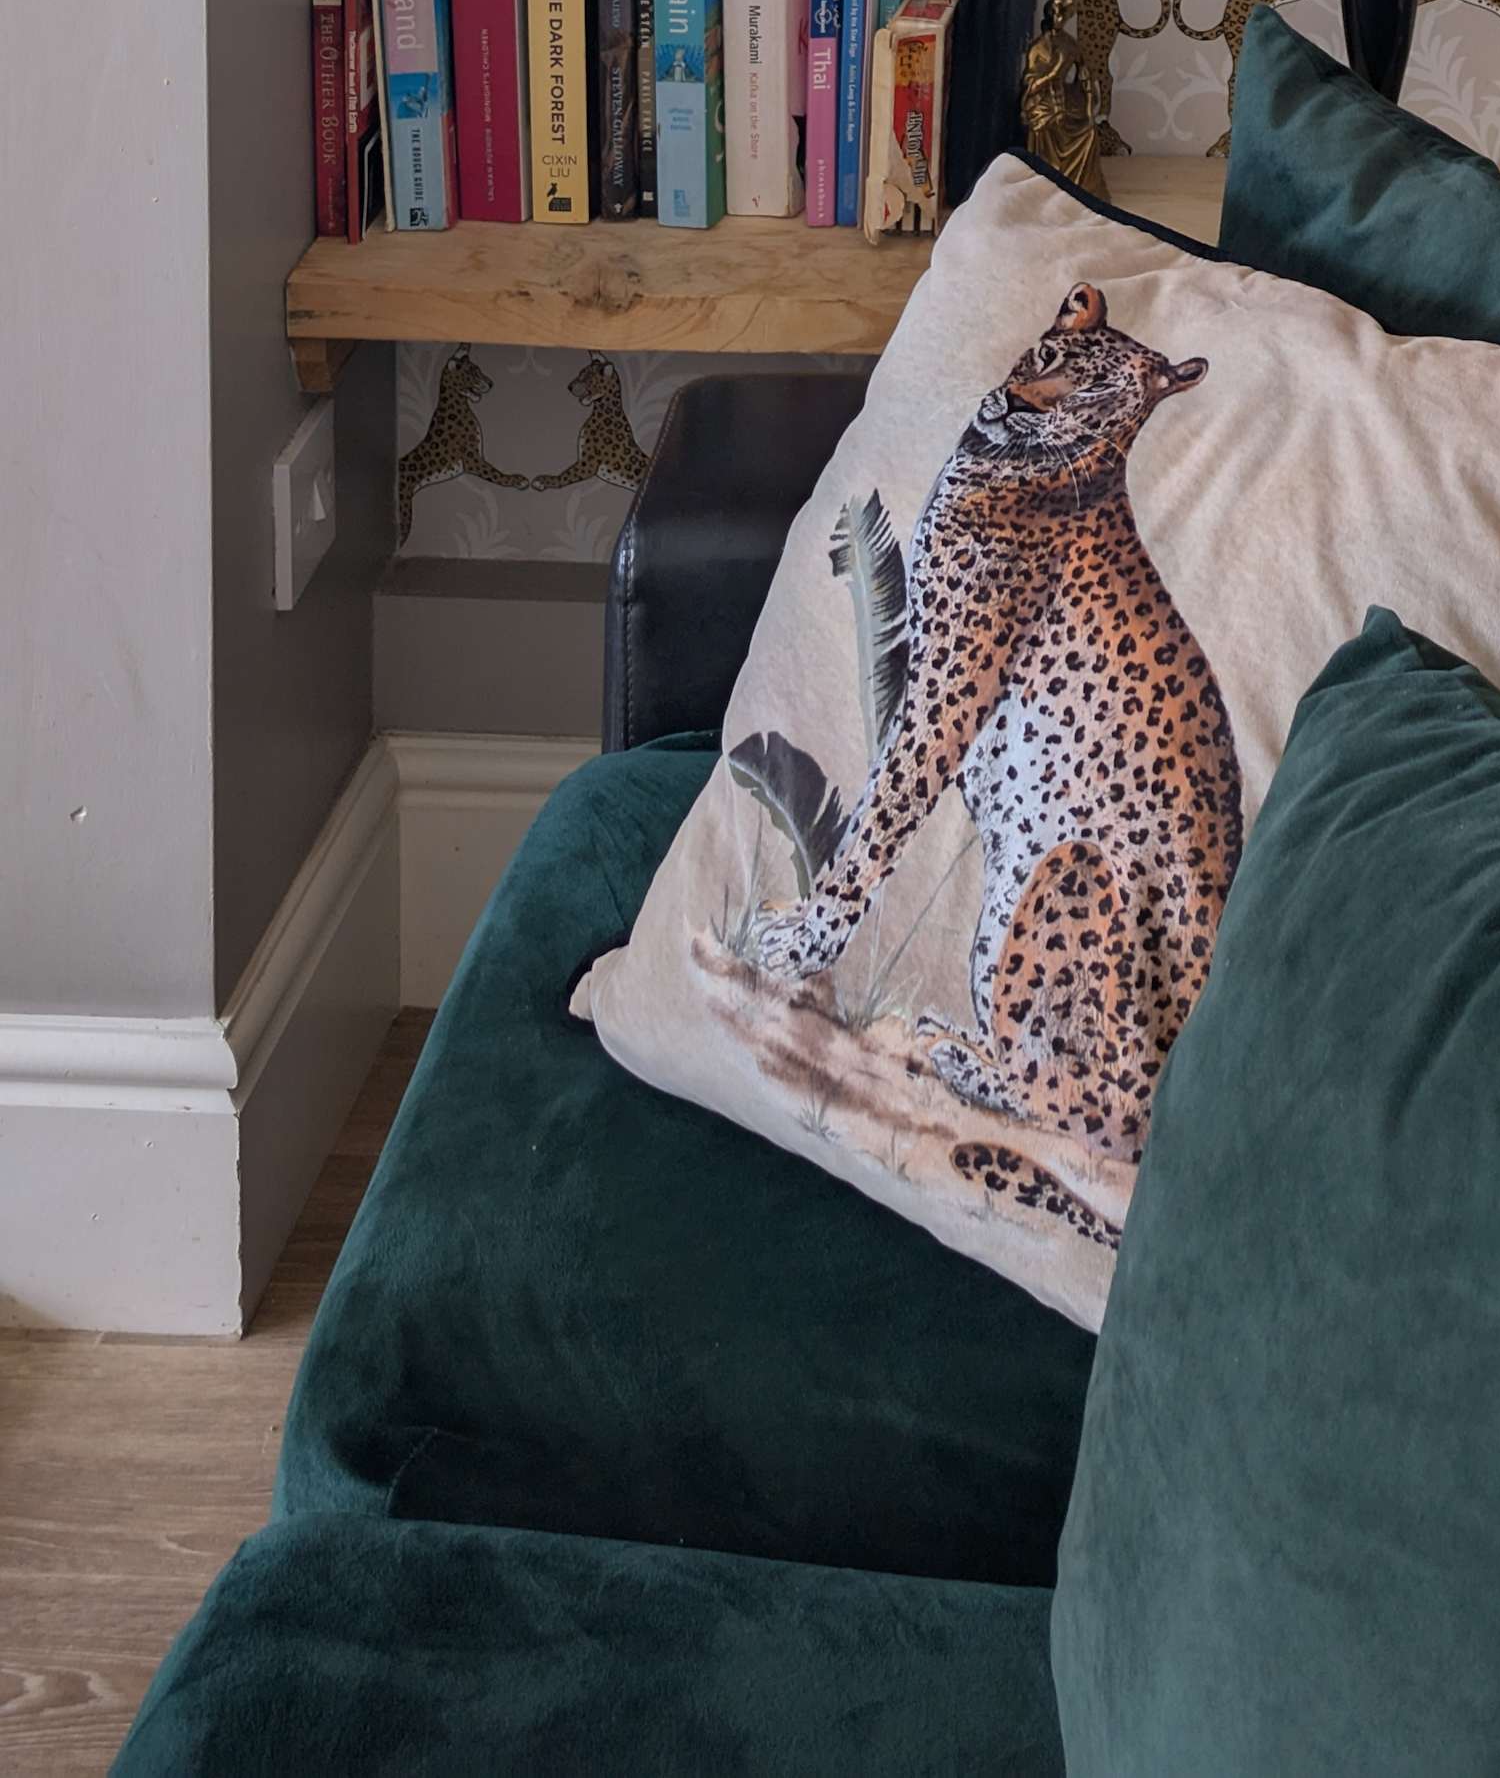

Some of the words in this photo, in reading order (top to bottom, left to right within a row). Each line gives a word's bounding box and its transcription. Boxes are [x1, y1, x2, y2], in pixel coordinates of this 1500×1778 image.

[320, 13, 335, 44] THE
[549, 18, 564, 68] DARK
[640, 12, 651, 48] STEIN
[749, 5, 762, 65] Murakami
[319, 47, 338, 109] OTHER
[813, 48, 832, 90] Thai
[612, 67, 623, 115] STEVEN
[640, 71, 651, 103] PARIS
[347, 111, 359, 133] Earth
[550, 75, 566, 145] FOREST
[750, 101, 758, 112] on
[750, 114, 760, 130] the
[321, 116, 339, 165] BOOK
[411, 129, 421, 143] THE
[612, 118, 624, 186] GALLOWAY
[750, 133, 760, 159] Shore
[412, 147, 422, 173] ROUGH
[542, 154, 578, 166] CIXIN
[550, 168, 570, 178] LIU
[414, 177, 424, 201] GUIDE
[816, 158, 827, 220] phrasebook
